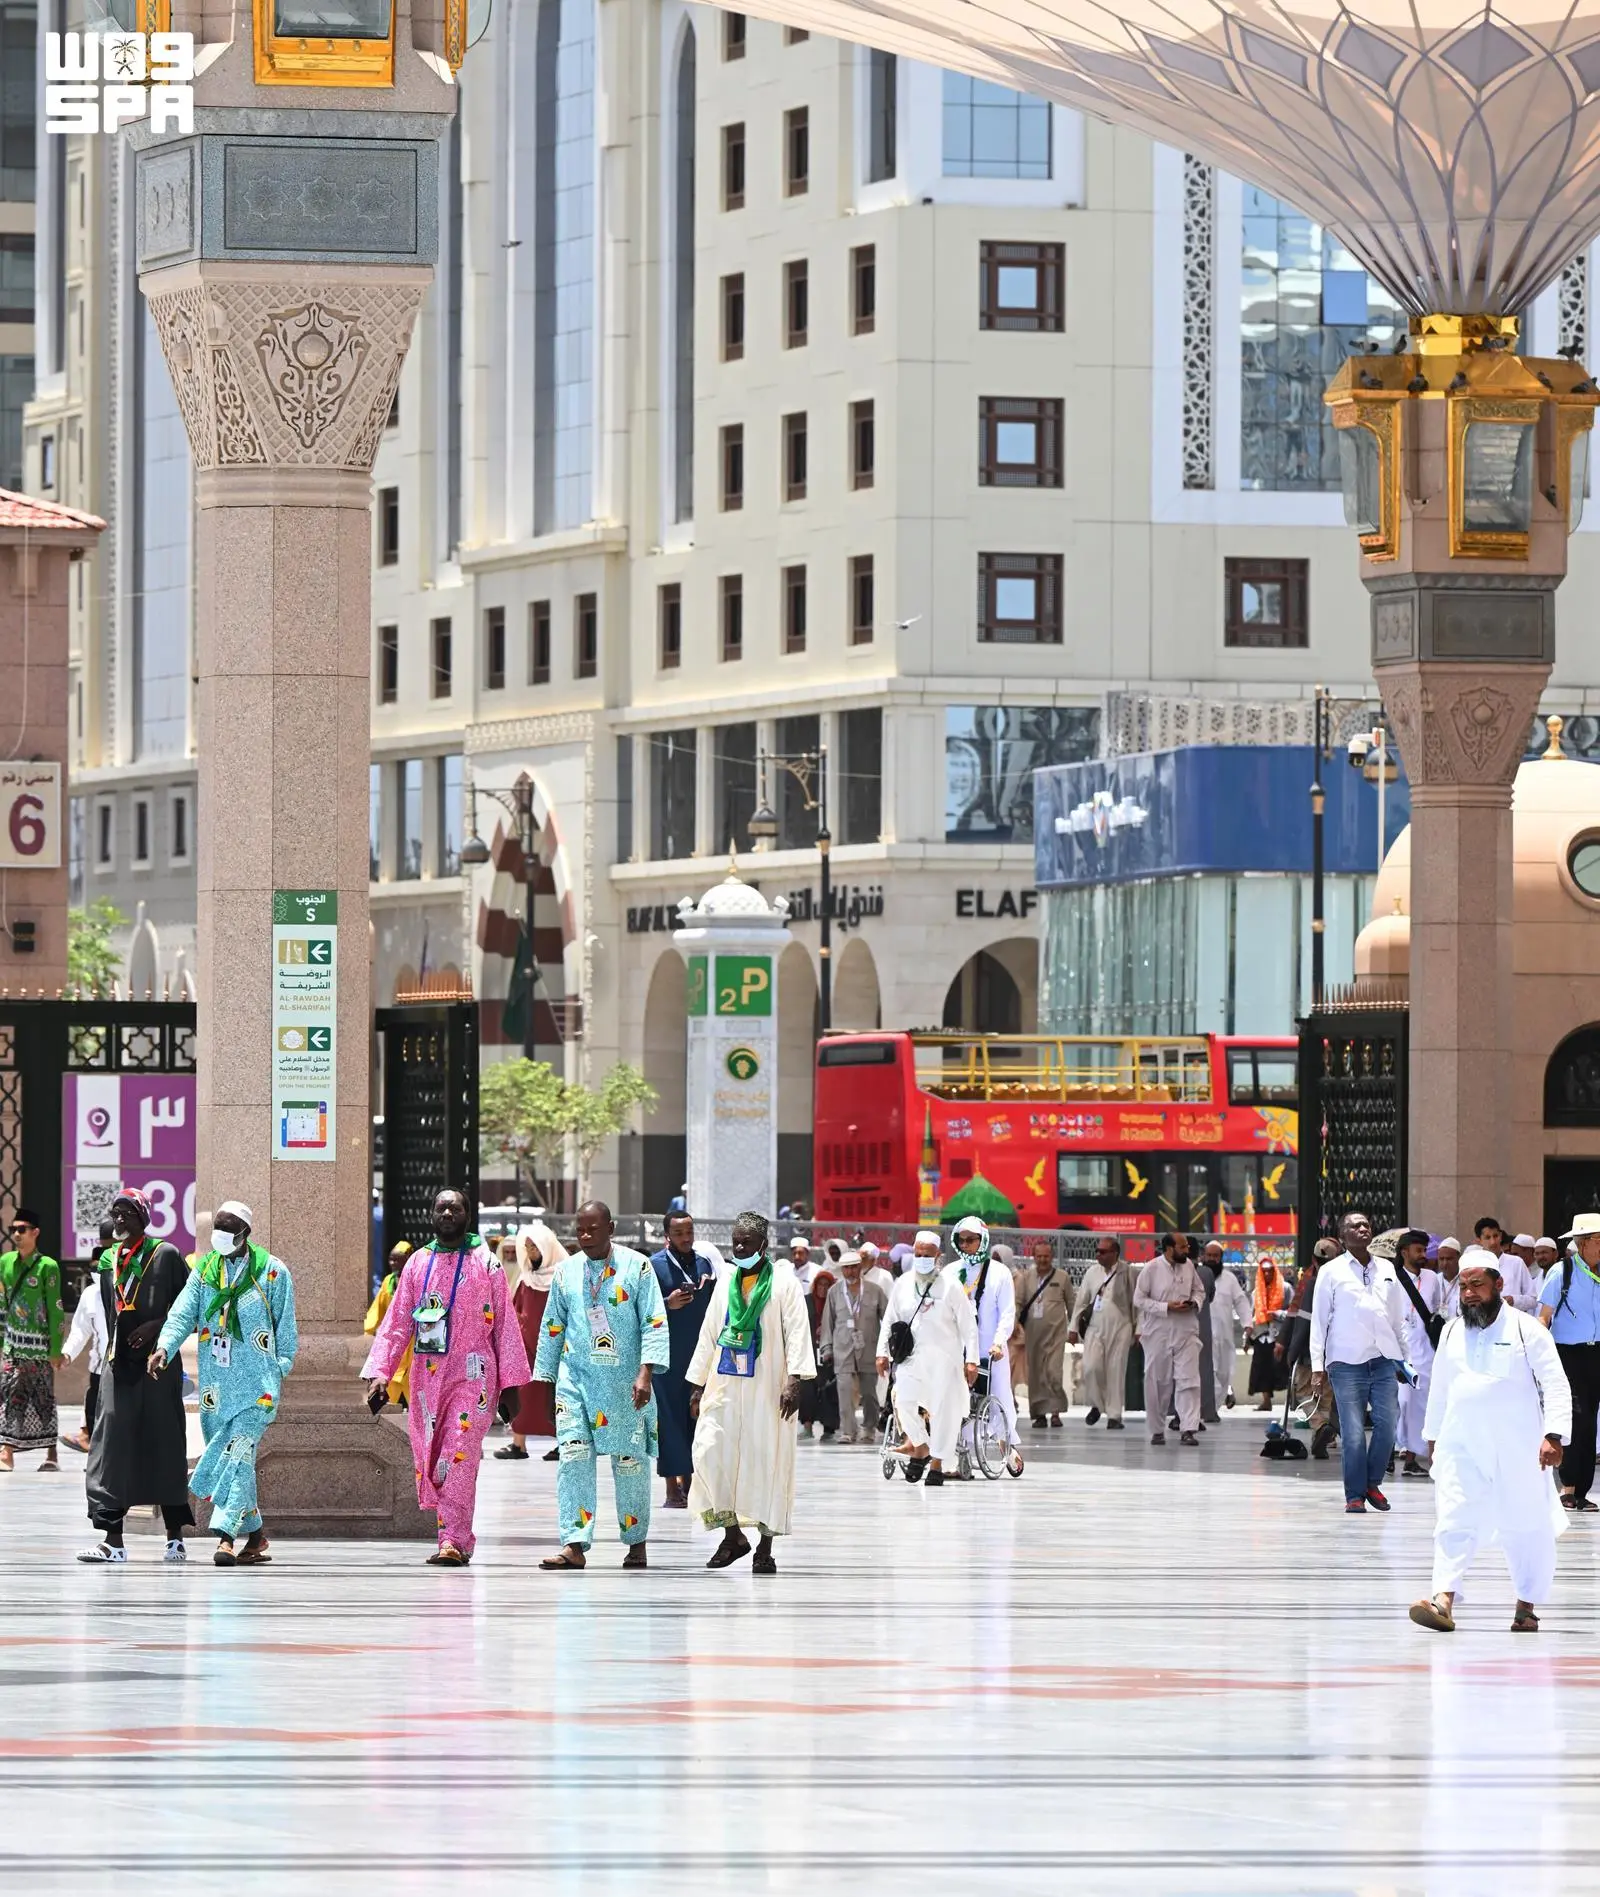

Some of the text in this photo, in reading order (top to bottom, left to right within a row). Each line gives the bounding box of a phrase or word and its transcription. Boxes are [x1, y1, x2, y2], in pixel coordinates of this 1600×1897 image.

[9, 793, 46, 856] 6
[296, 894, 326, 906] الجنوب
[956, 889, 1039, 918] ELAF
[305, 907, 316, 922] S
[279, 969, 331, 979] الروضة
[279, 981, 331, 991] الشريفة
[279, 994, 331, 1002] AL-RAWDAH
